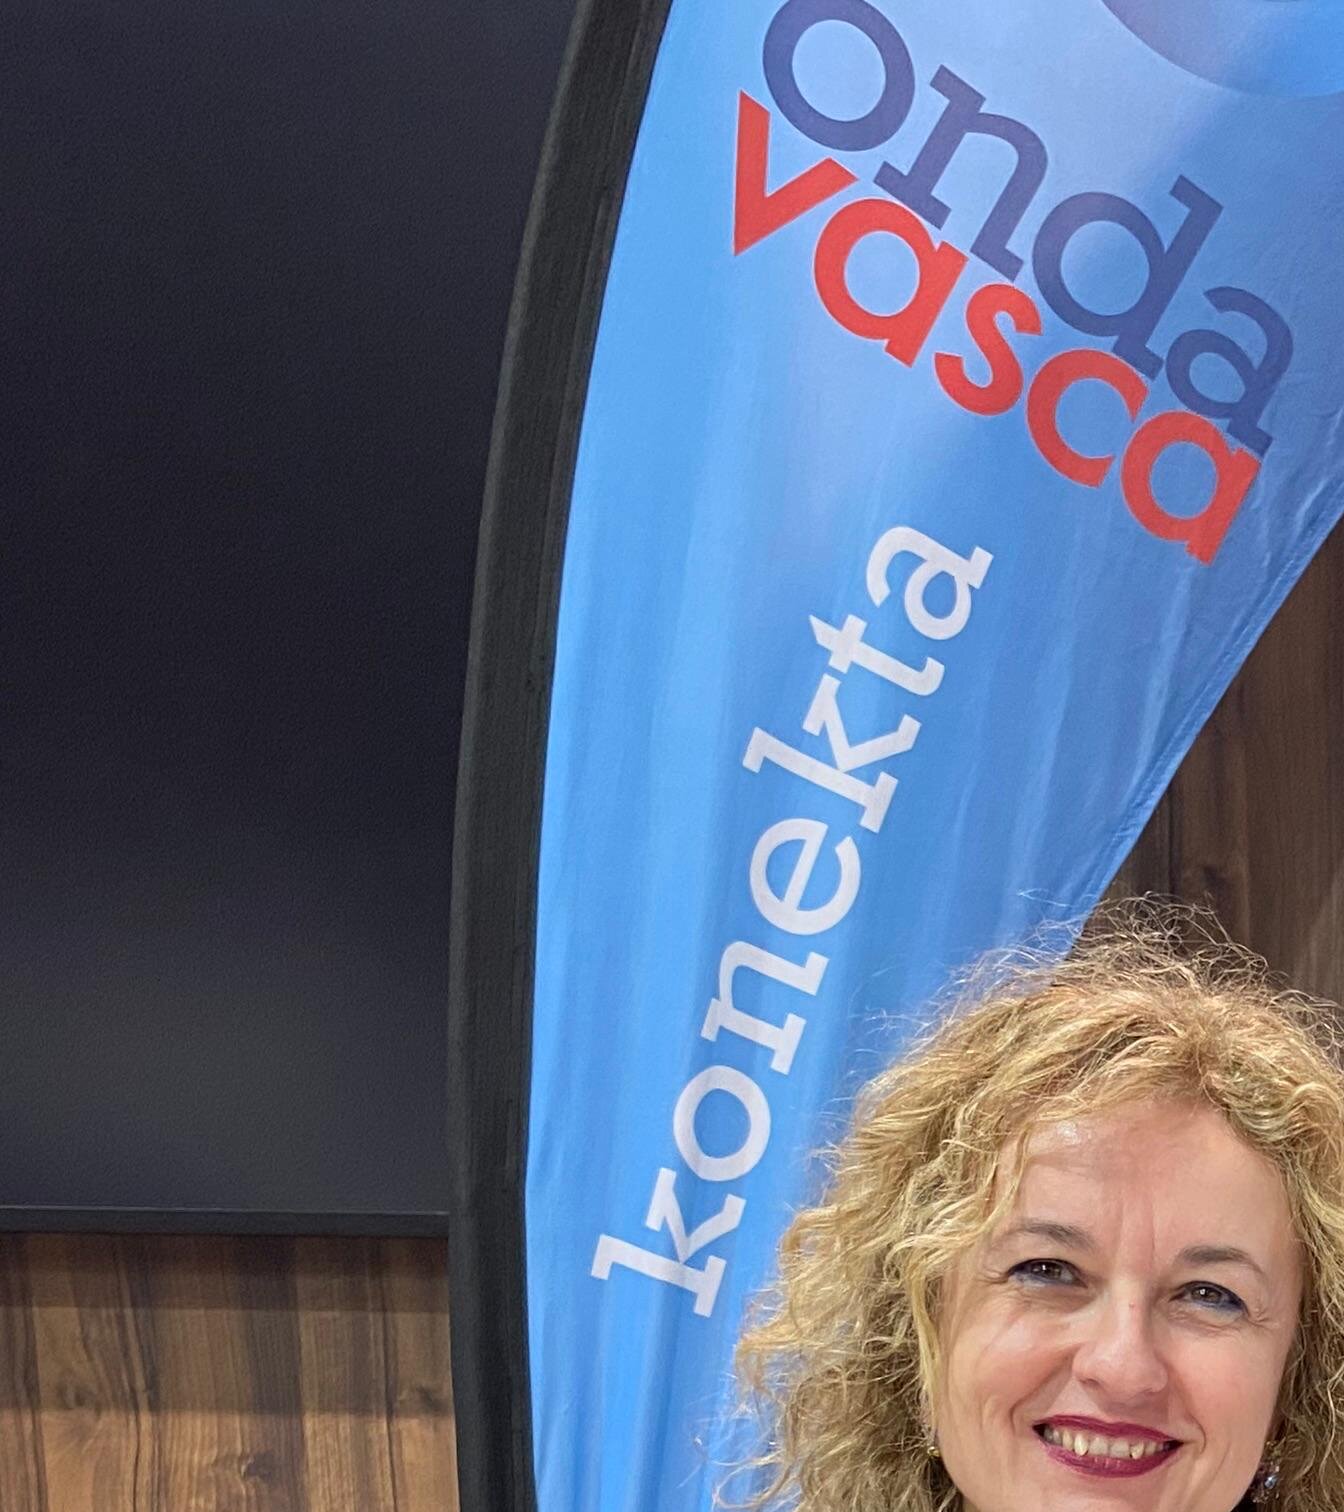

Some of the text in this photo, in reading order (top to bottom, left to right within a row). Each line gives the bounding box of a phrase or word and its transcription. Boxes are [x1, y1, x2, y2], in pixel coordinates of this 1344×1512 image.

[733, 88, 1265, 566] vasca
[762, 0, 1298, 459] onda
[590, 525, 995, 1319] konekta
